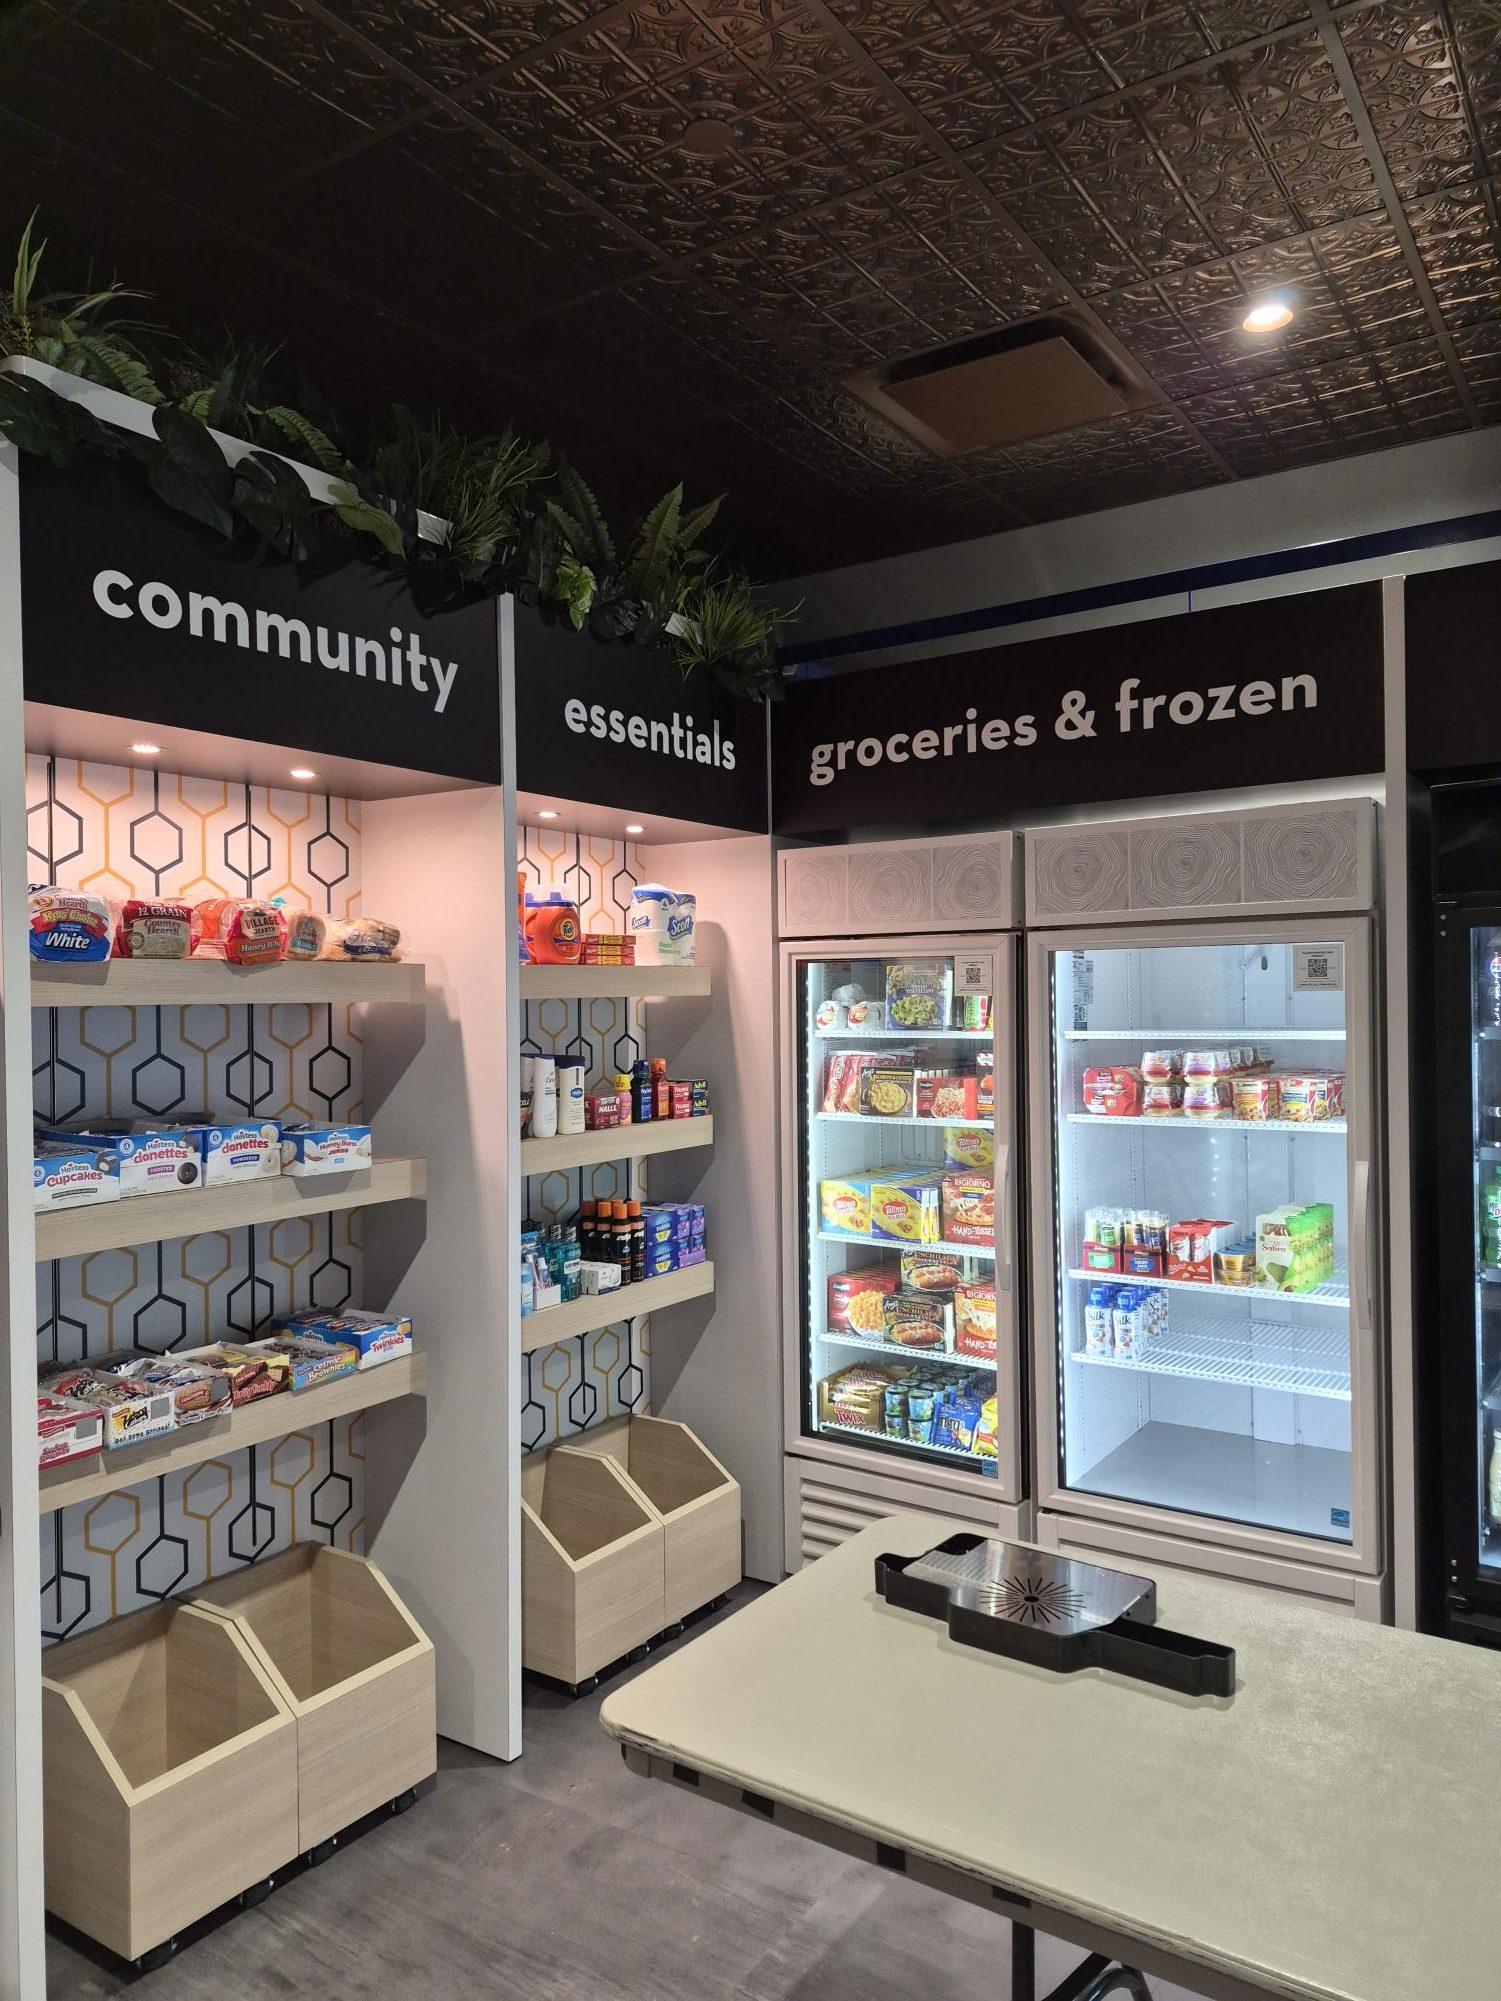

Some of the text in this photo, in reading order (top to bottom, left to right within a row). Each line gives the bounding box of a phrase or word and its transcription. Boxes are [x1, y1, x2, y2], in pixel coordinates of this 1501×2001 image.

[92, 570, 459, 713] community
[564, 699, 737, 770] essentials
[809, 673, 1318, 787] groceries & frozen
[151, 906, 188, 919] GRAIN
[244, 916, 280, 929] VILLAGE
[562, 923, 574, 936] Tide
[670, 917, 692, 936] Scott
[46, 931, 90, 950] White
[241, 943, 266, 952] Honey
[694, 1081, 706, 1089] Advil
[694, 1100, 707, 1108] Advil
[148, 1141, 175, 1150] Hostess
[222, 1139, 269, 1154] donettes
[134, 1148, 188, 1164] donettes
[61, 1164, 90, 1174] Hostess
[47, 1171, 103, 1188] Cupcakes
[372, 1336, 404, 1353] Twinkies
[308, 1362, 347, 1383] Brownies
[313, 1357, 342, 1373] Cosmic
